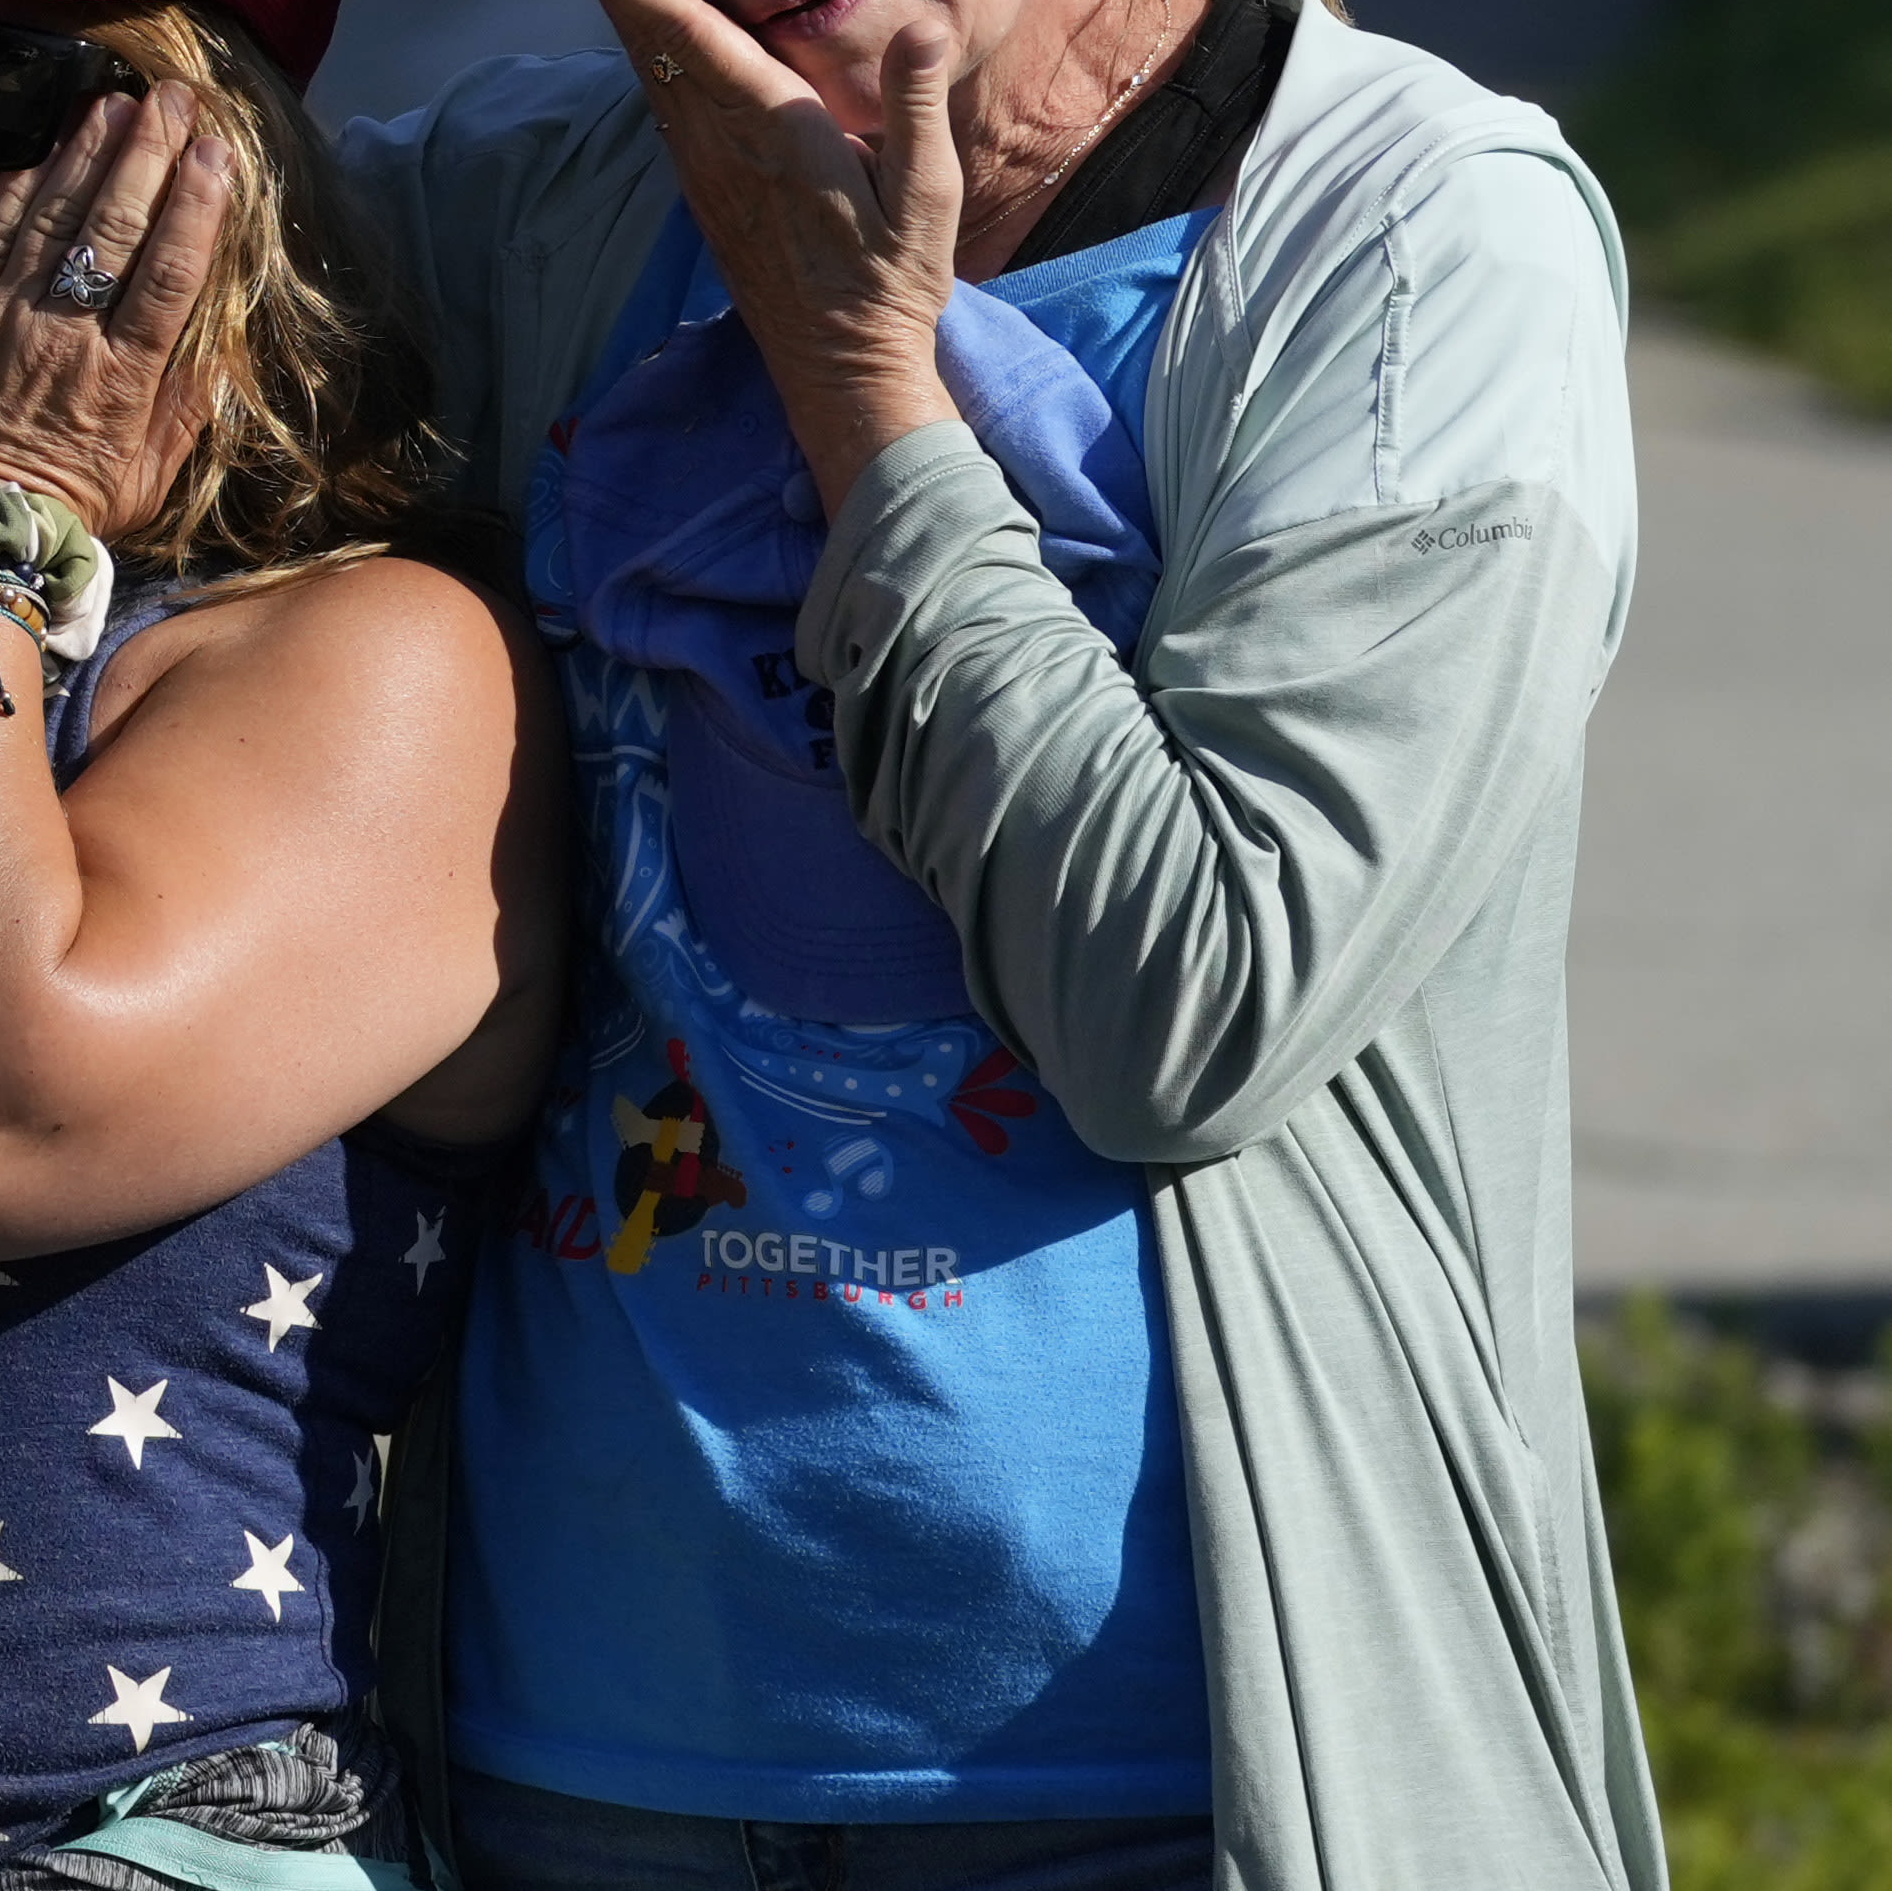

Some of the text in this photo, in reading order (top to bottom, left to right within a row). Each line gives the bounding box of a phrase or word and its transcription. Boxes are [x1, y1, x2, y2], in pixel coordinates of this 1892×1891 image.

[1438, 516, 1534, 551] Columbia
[701, 1230, 962, 1286] TOGETHER
[697, 1273, 963, 1310] PITTSBURGH
